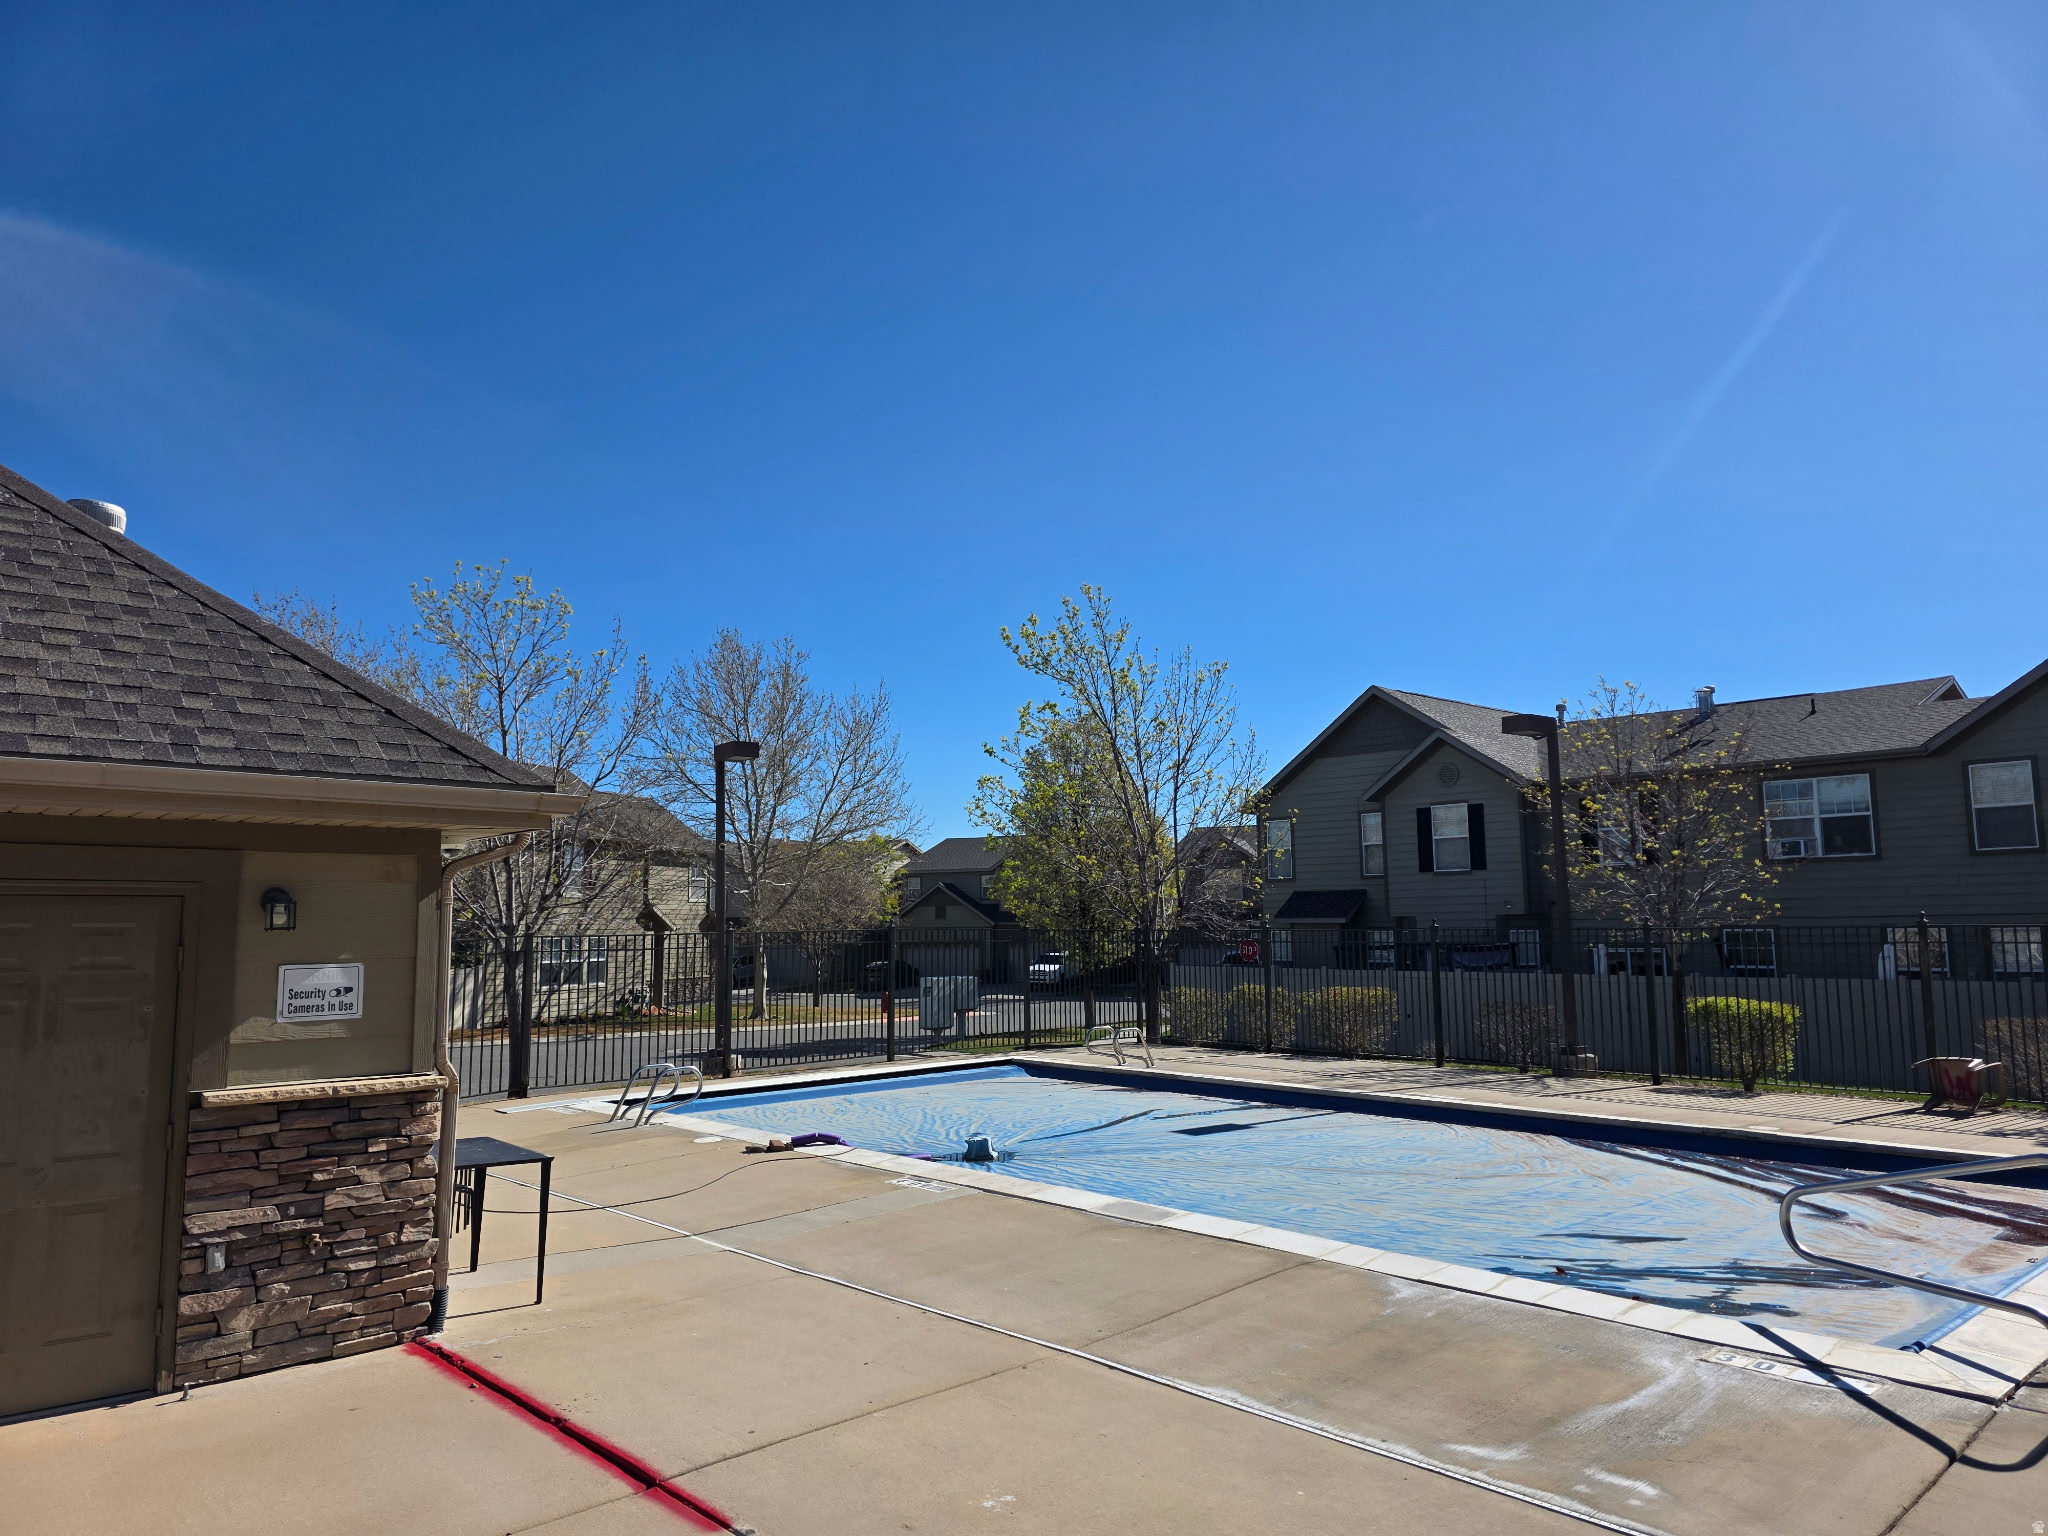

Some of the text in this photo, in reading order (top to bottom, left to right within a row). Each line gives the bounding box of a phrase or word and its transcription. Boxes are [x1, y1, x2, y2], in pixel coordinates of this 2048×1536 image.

[288, 988, 326, 1000] Security
[287, 1000, 353, 1014] Cameras In Use
[1714, 1353, 1737, 1362] 3
